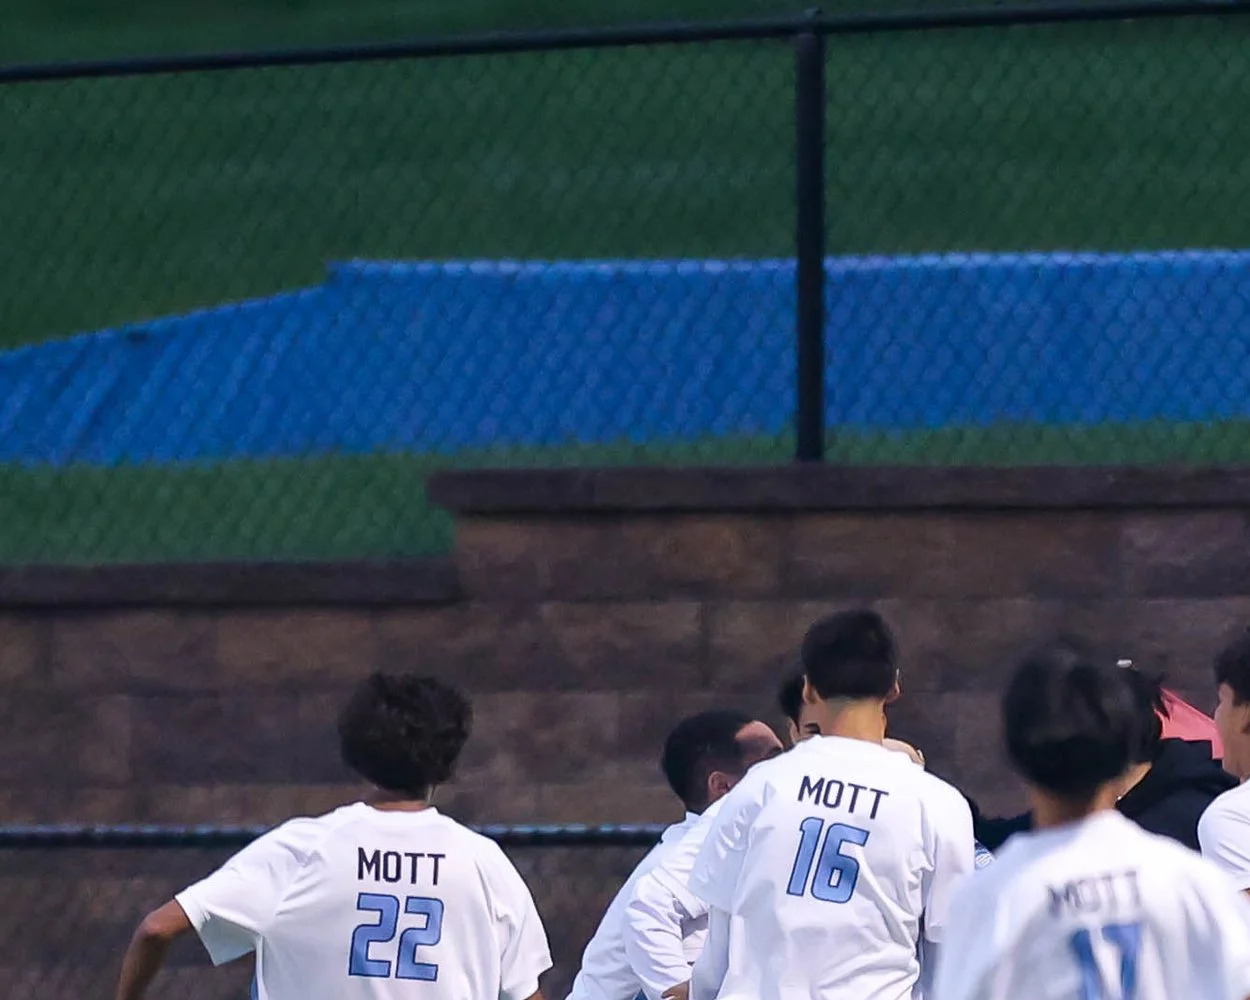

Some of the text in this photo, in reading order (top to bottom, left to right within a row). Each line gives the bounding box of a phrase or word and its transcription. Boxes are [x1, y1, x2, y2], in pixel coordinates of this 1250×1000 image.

[797, 775, 889, 820] MOTT
[357, 846, 446, 886] MOTT
[786, 816, 870, 903] 16
[1046, 870, 1142, 919] MOTT
[348, 892, 444, 982] 22
